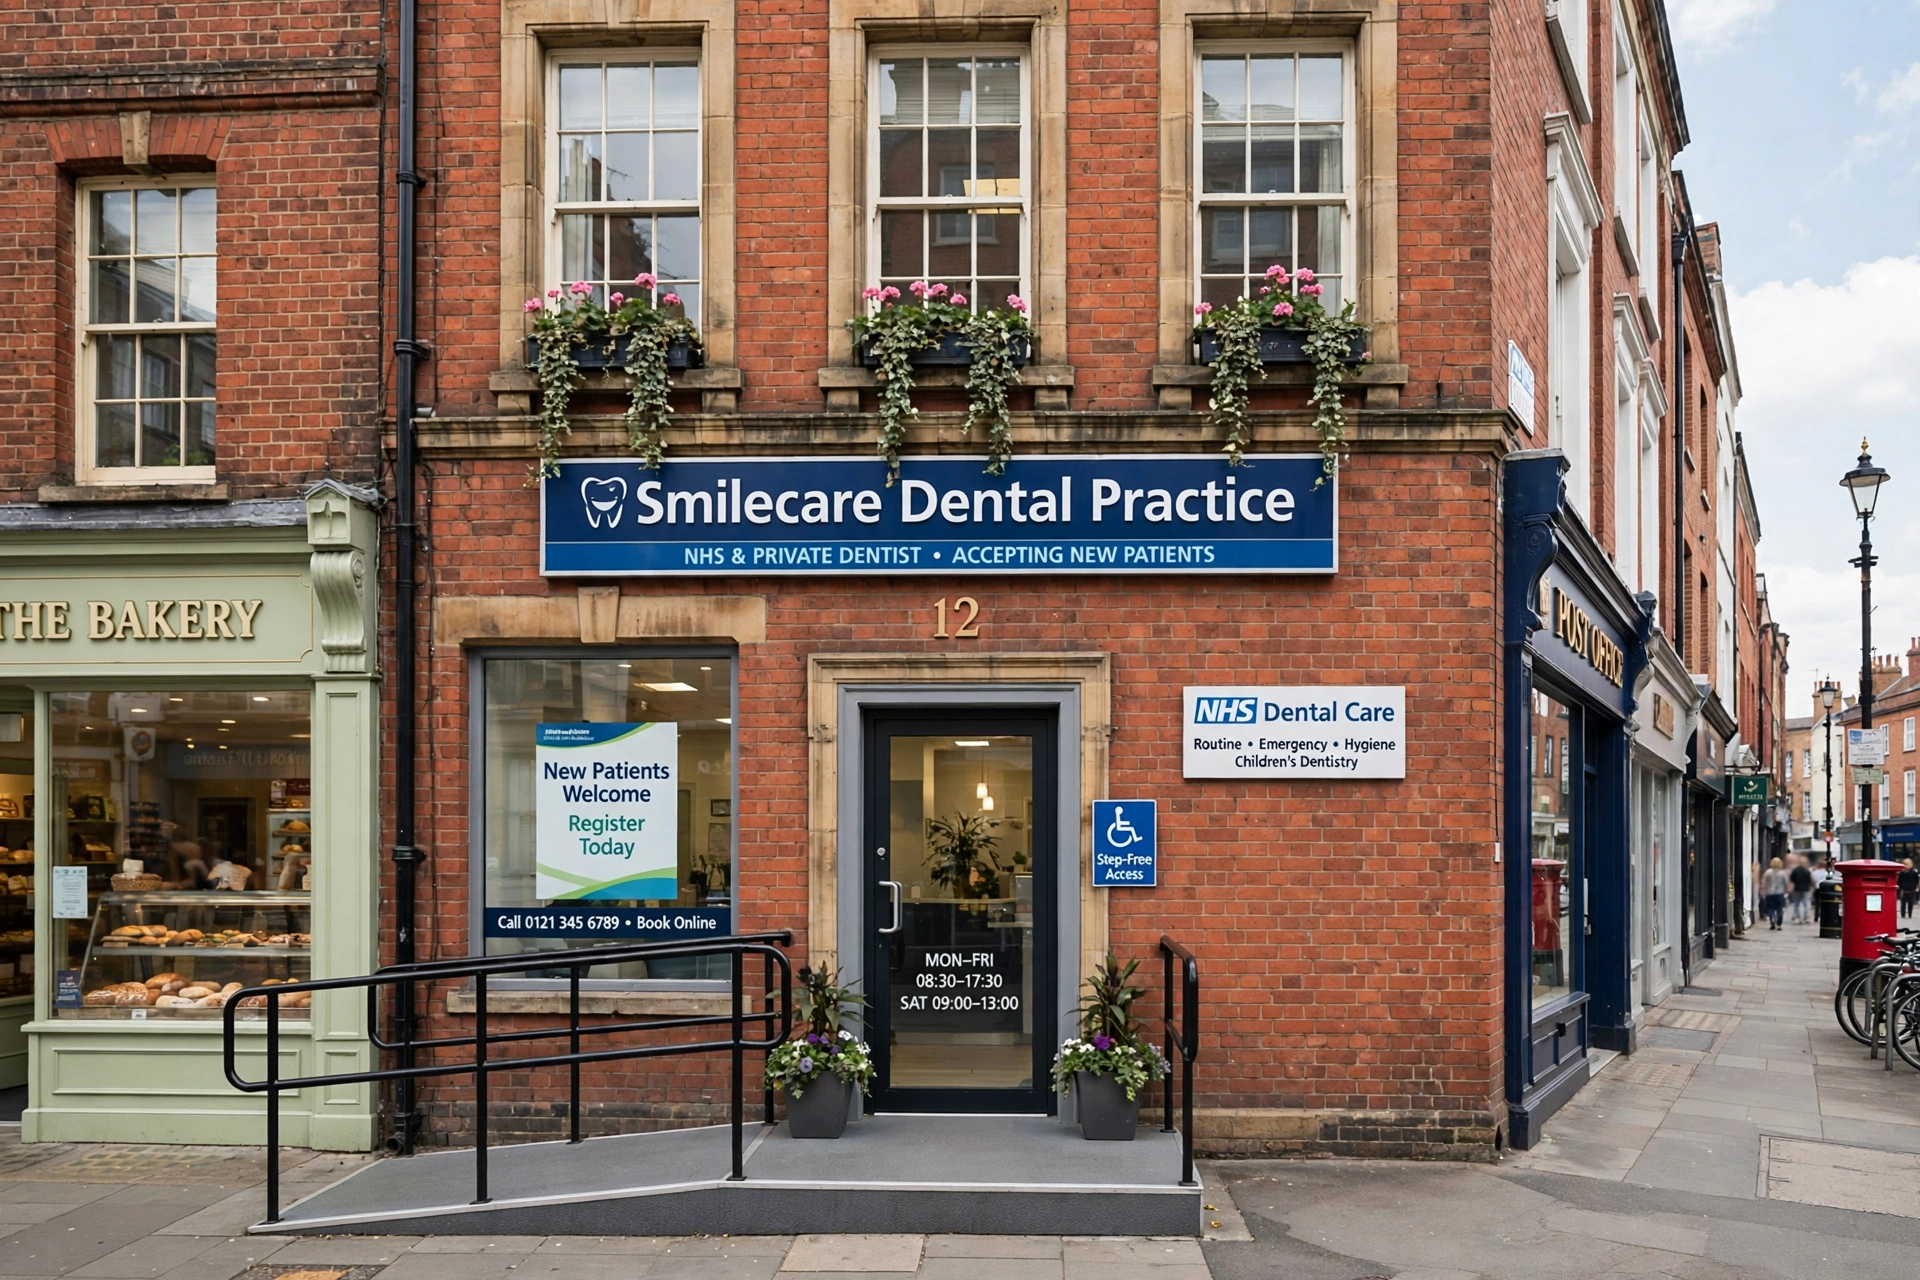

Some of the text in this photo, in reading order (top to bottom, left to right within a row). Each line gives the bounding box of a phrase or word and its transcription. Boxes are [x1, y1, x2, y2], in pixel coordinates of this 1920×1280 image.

[635, 475, 1295, 525] Smilecare Dental Practice
[684, 546, 1216, 566] NHS & PRIVATE DENTIST ACCEPTING NEW PATIENTS
[87, 600, 263, 640] BAKERY
[932, 597, 980, 639] 12
[1556, 586, 1624, 689] POST OFFICE
[1196, 699, 1395, 722] NHS Dental Care
[1193, 737, 1396, 754] Routine Emergency Hygiene
[543, 761, 670, 780] New Patients
[1234, 755, 1359, 771] Children's Dentistry
[562, 784, 652, 803] Welcome
[568, 814, 646, 836] Register
[579, 837, 635, 860] Today
[1096, 853, 1153, 868] Step-Free
[1105, 868, 1144, 880] Access
[497, 914, 717, 930] Call 0121 345 6789 Book Online
[900, 995, 928, 1010] SAT
